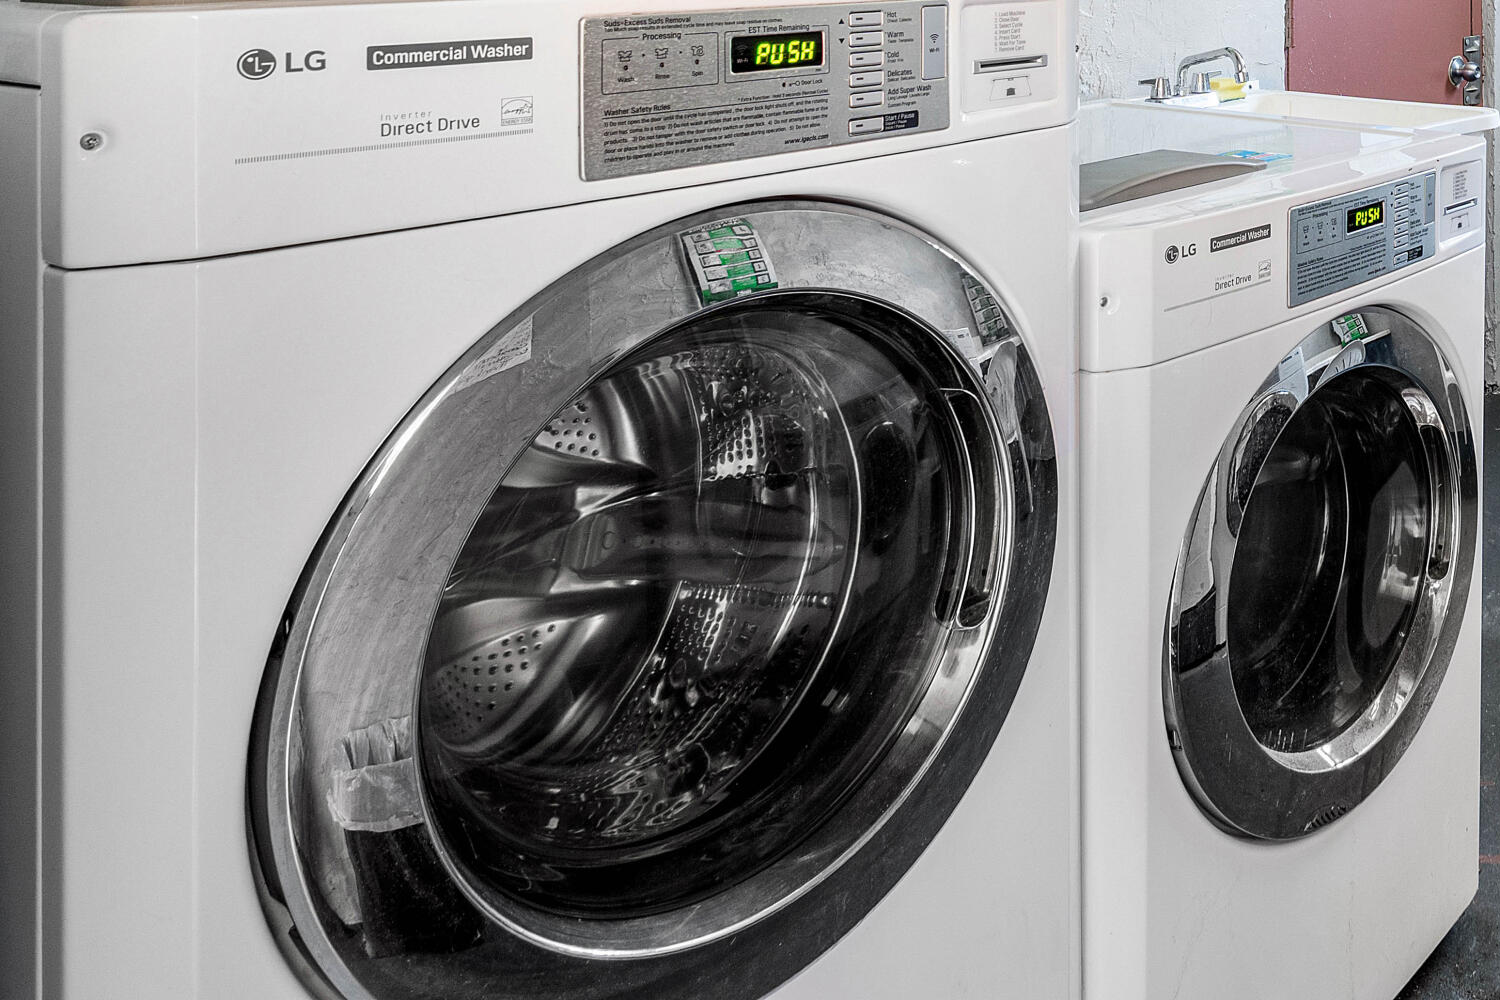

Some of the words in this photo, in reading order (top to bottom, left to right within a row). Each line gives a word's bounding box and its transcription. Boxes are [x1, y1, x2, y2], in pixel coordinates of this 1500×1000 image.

[642, 32, 682, 41] Processing
[749, 26, 760, 34] EST
[779, 24, 810, 32] Remaining
[285, 50, 326, 72] LG
[372, 45, 467, 66] Commercial
[472, 43, 529, 60] Washer
[756, 41, 814, 65] PUSH
[381, 111, 432, 122] Inverter
[631, 106, 652, 114] Safety
[381, 120, 432, 137] Direct
[438, 117, 480, 131] Drive
[1356, 207, 1380, 226] PUSH
[1212, 233, 1247, 249] Commercial
[1248, 228, 1270, 241] Washer
[1182, 244, 1196, 258] LG
[1215, 279, 1234, 291] Direct
[1236, 274, 1252, 285] Drive
